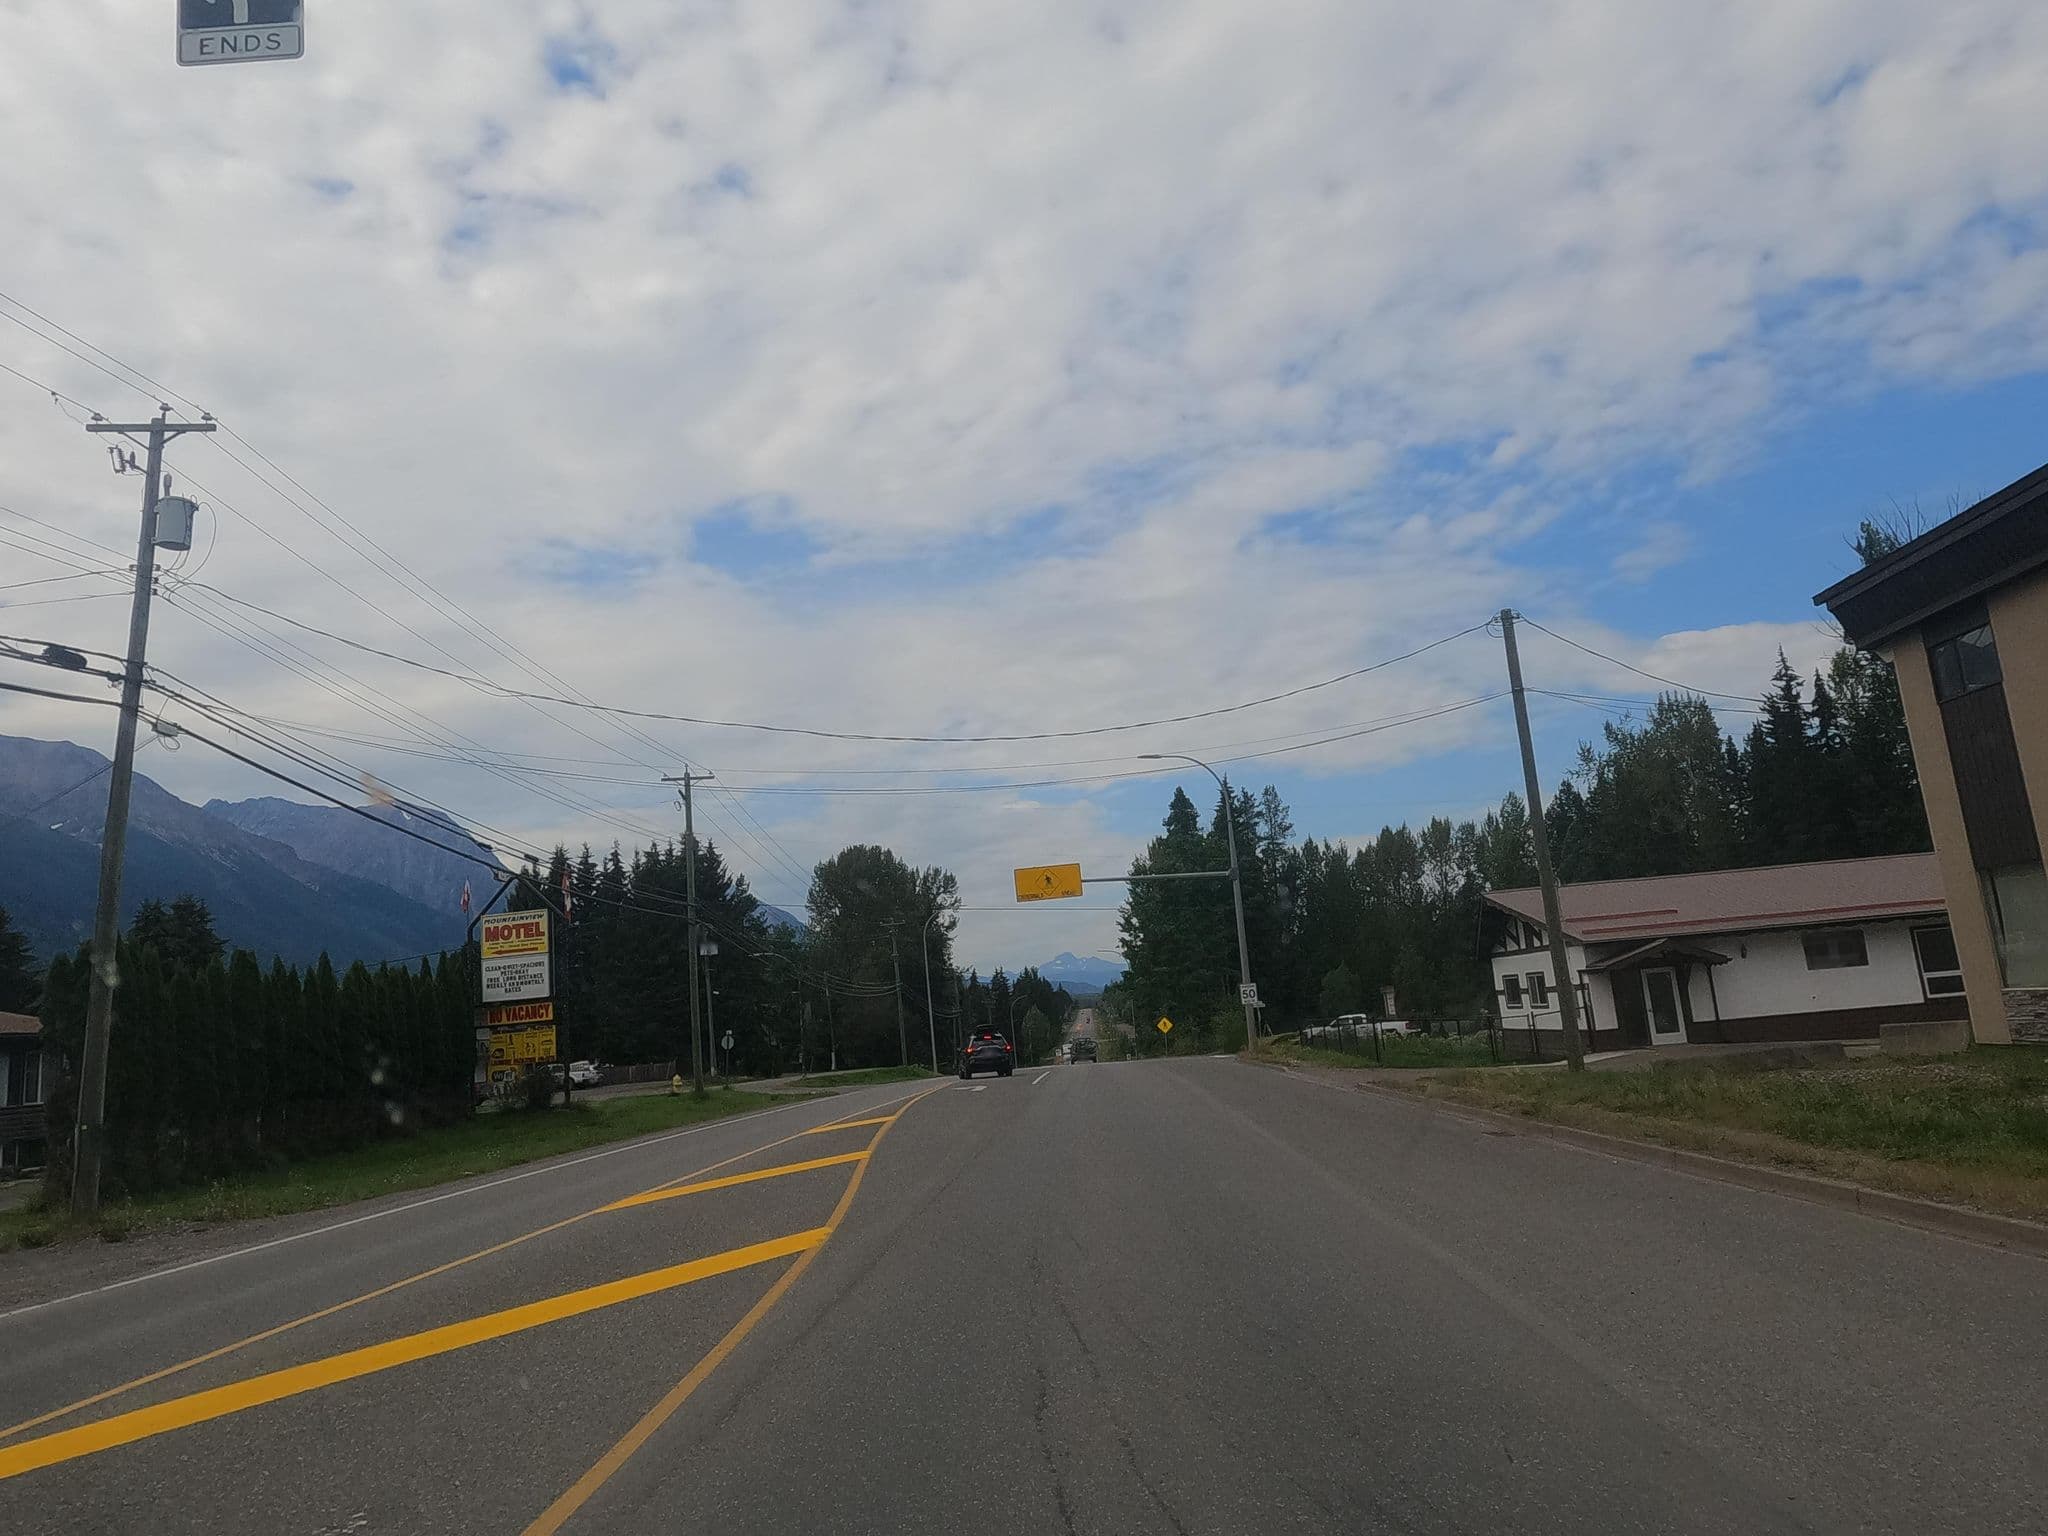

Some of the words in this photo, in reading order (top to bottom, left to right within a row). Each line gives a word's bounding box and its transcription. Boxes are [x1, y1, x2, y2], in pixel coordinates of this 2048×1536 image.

[199, 33, 281, 55] ENDS
[484, 913, 544, 925] MOUNTAINVIEW
[485, 921, 545, 942] MOTEL
[1242, 989, 1255, 998] 50
[489, 1010, 503, 1024] NO
[506, 1004, 550, 1021] VACANCY
